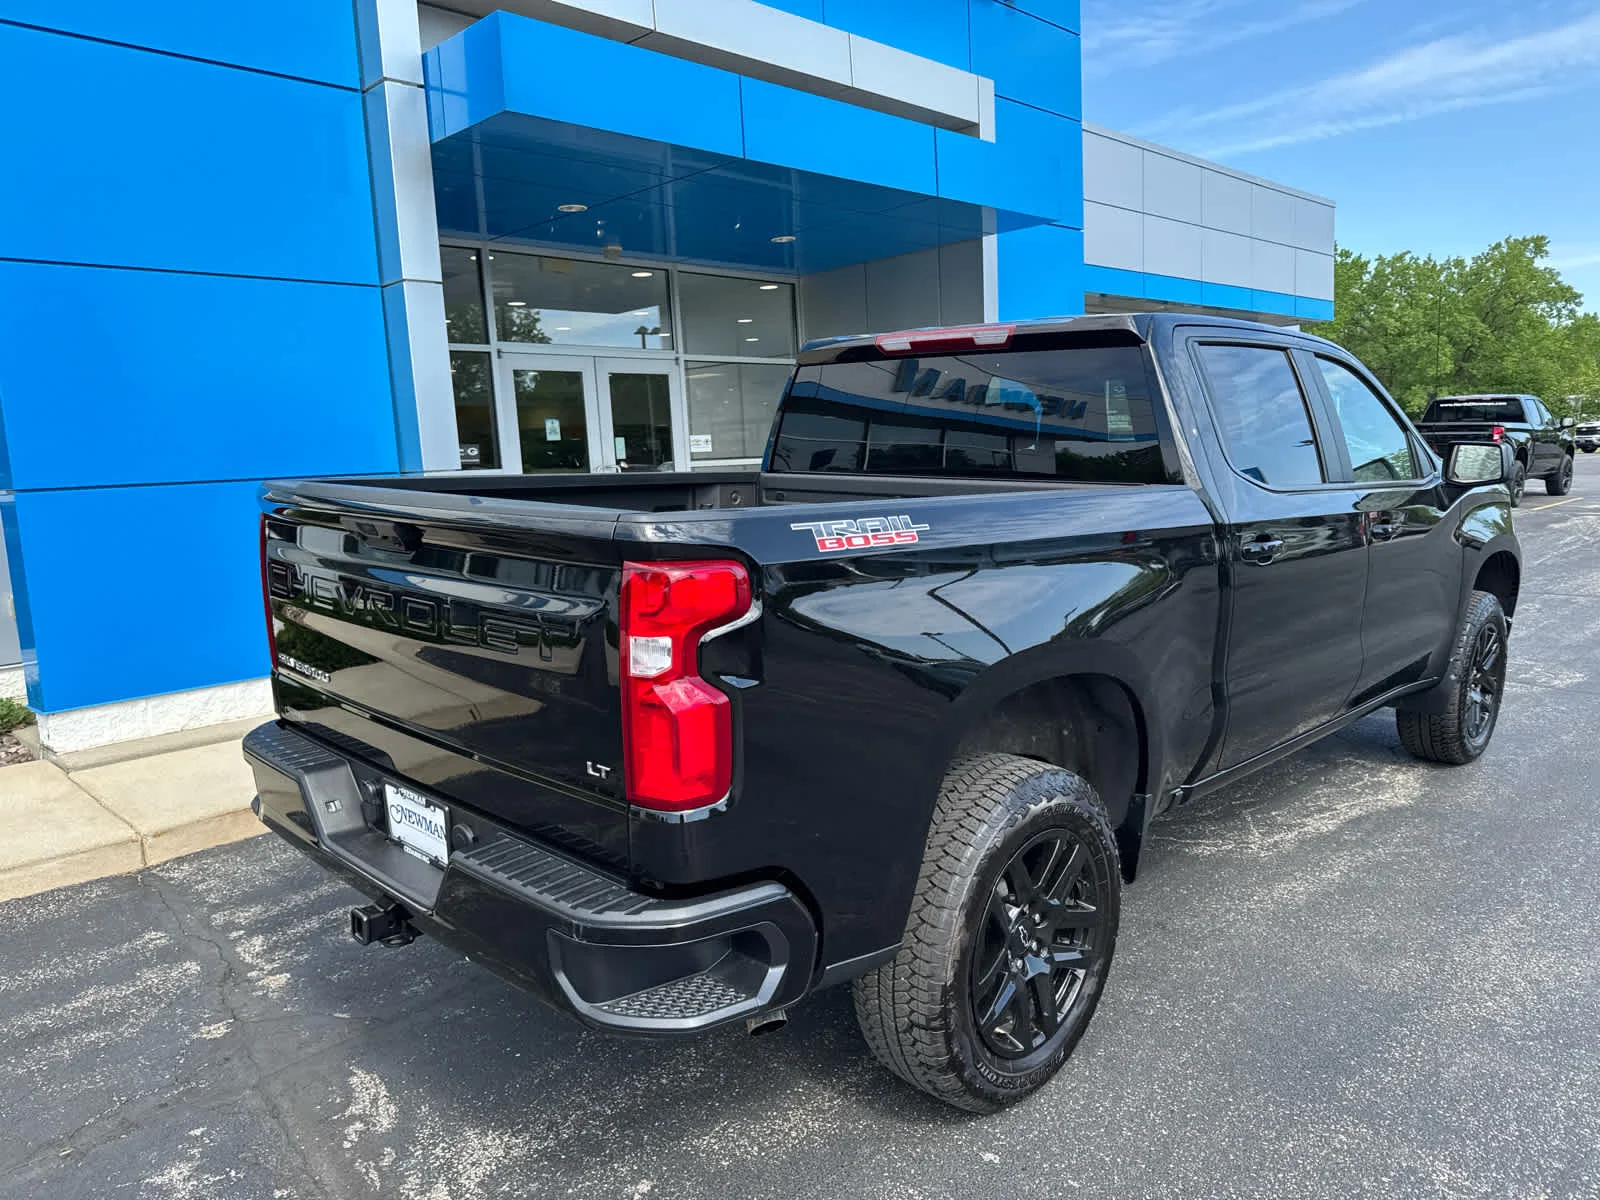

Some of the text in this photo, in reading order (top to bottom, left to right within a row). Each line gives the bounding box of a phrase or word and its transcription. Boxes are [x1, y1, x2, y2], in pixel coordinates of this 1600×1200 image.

[790, 515, 930, 538] TRAIL
[816, 530, 919, 552] BOSS
[268, 559, 582, 662] CHEVROLET
[586, 760, 611, 779] LT
[389, 803, 447, 840] NEWMAN
